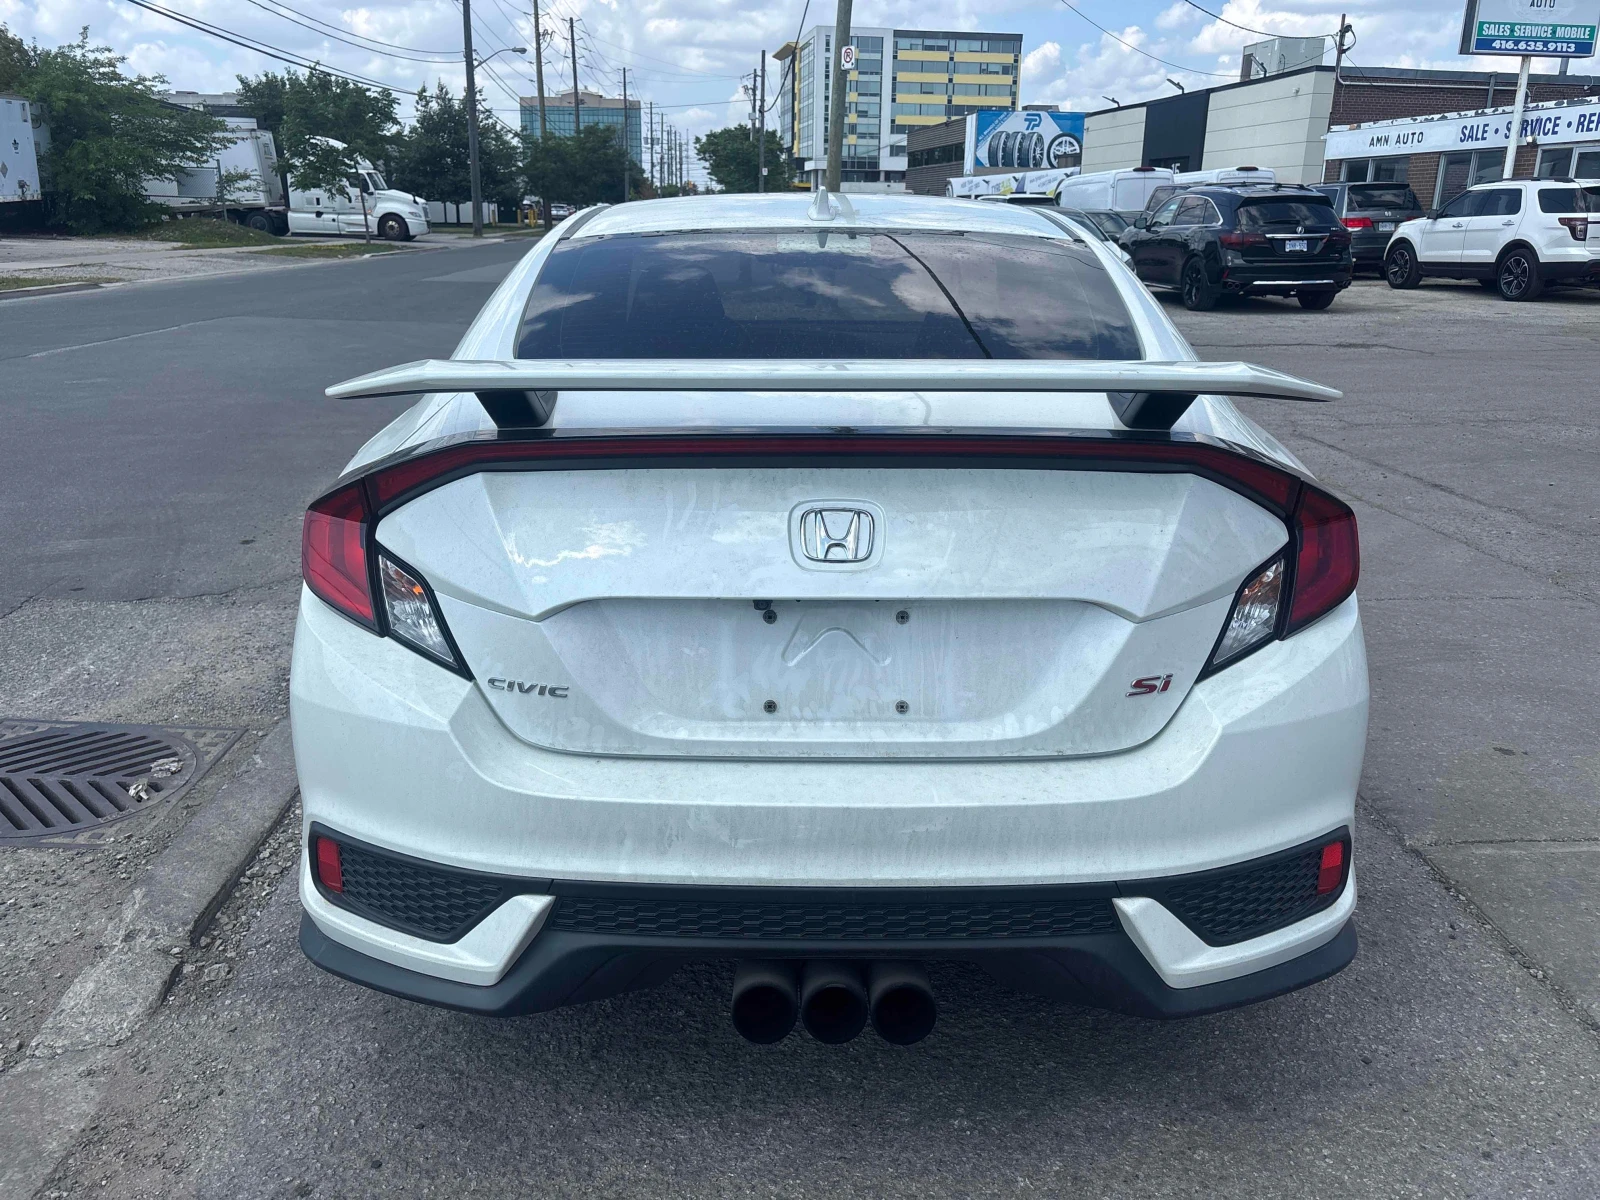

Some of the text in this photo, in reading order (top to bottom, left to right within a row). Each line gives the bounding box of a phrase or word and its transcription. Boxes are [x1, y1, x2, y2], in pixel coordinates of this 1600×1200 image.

[1530, 0, 1555, 8] AUTO
[1482, 24, 1591, 39] SALES SERVICE MOBILE
[1492, 40, 1575, 52] 416.635.9113
[1460, 123, 1489, 143] SALE
[1504, 116, 1561, 140] SRVICE
[1369, 131, 1424, 147] AMN AUTO
[487, 677, 569, 698] CIVIC
[1125, 673, 1173, 697] Si
